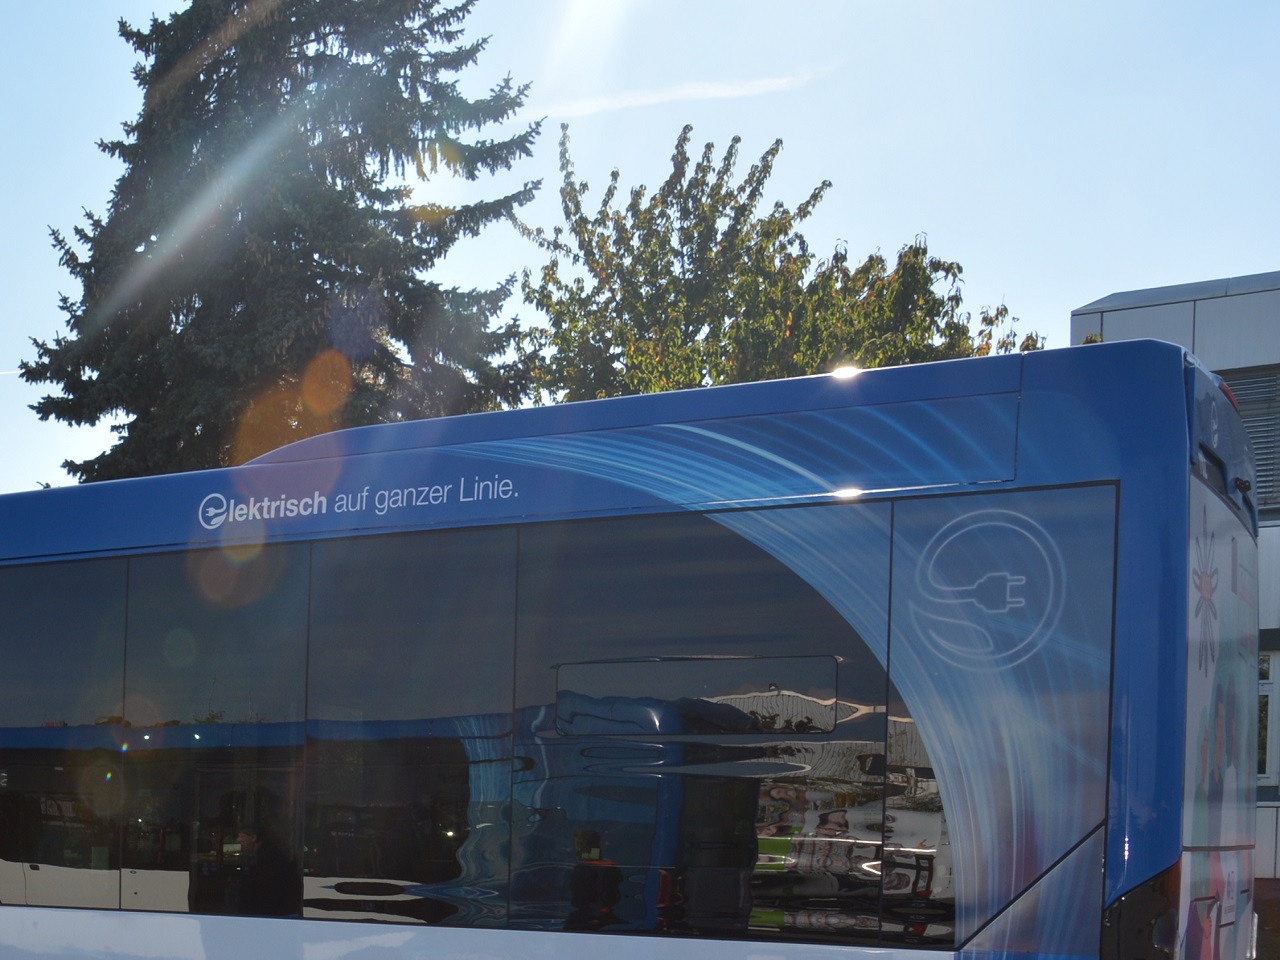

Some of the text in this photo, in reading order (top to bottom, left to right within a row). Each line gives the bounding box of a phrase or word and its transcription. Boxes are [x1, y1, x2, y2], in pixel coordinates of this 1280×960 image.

[334, 486, 370, 513] auf
[374, 484, 453, 515] ganzer
[459, 474, 519, 502] Linie.
